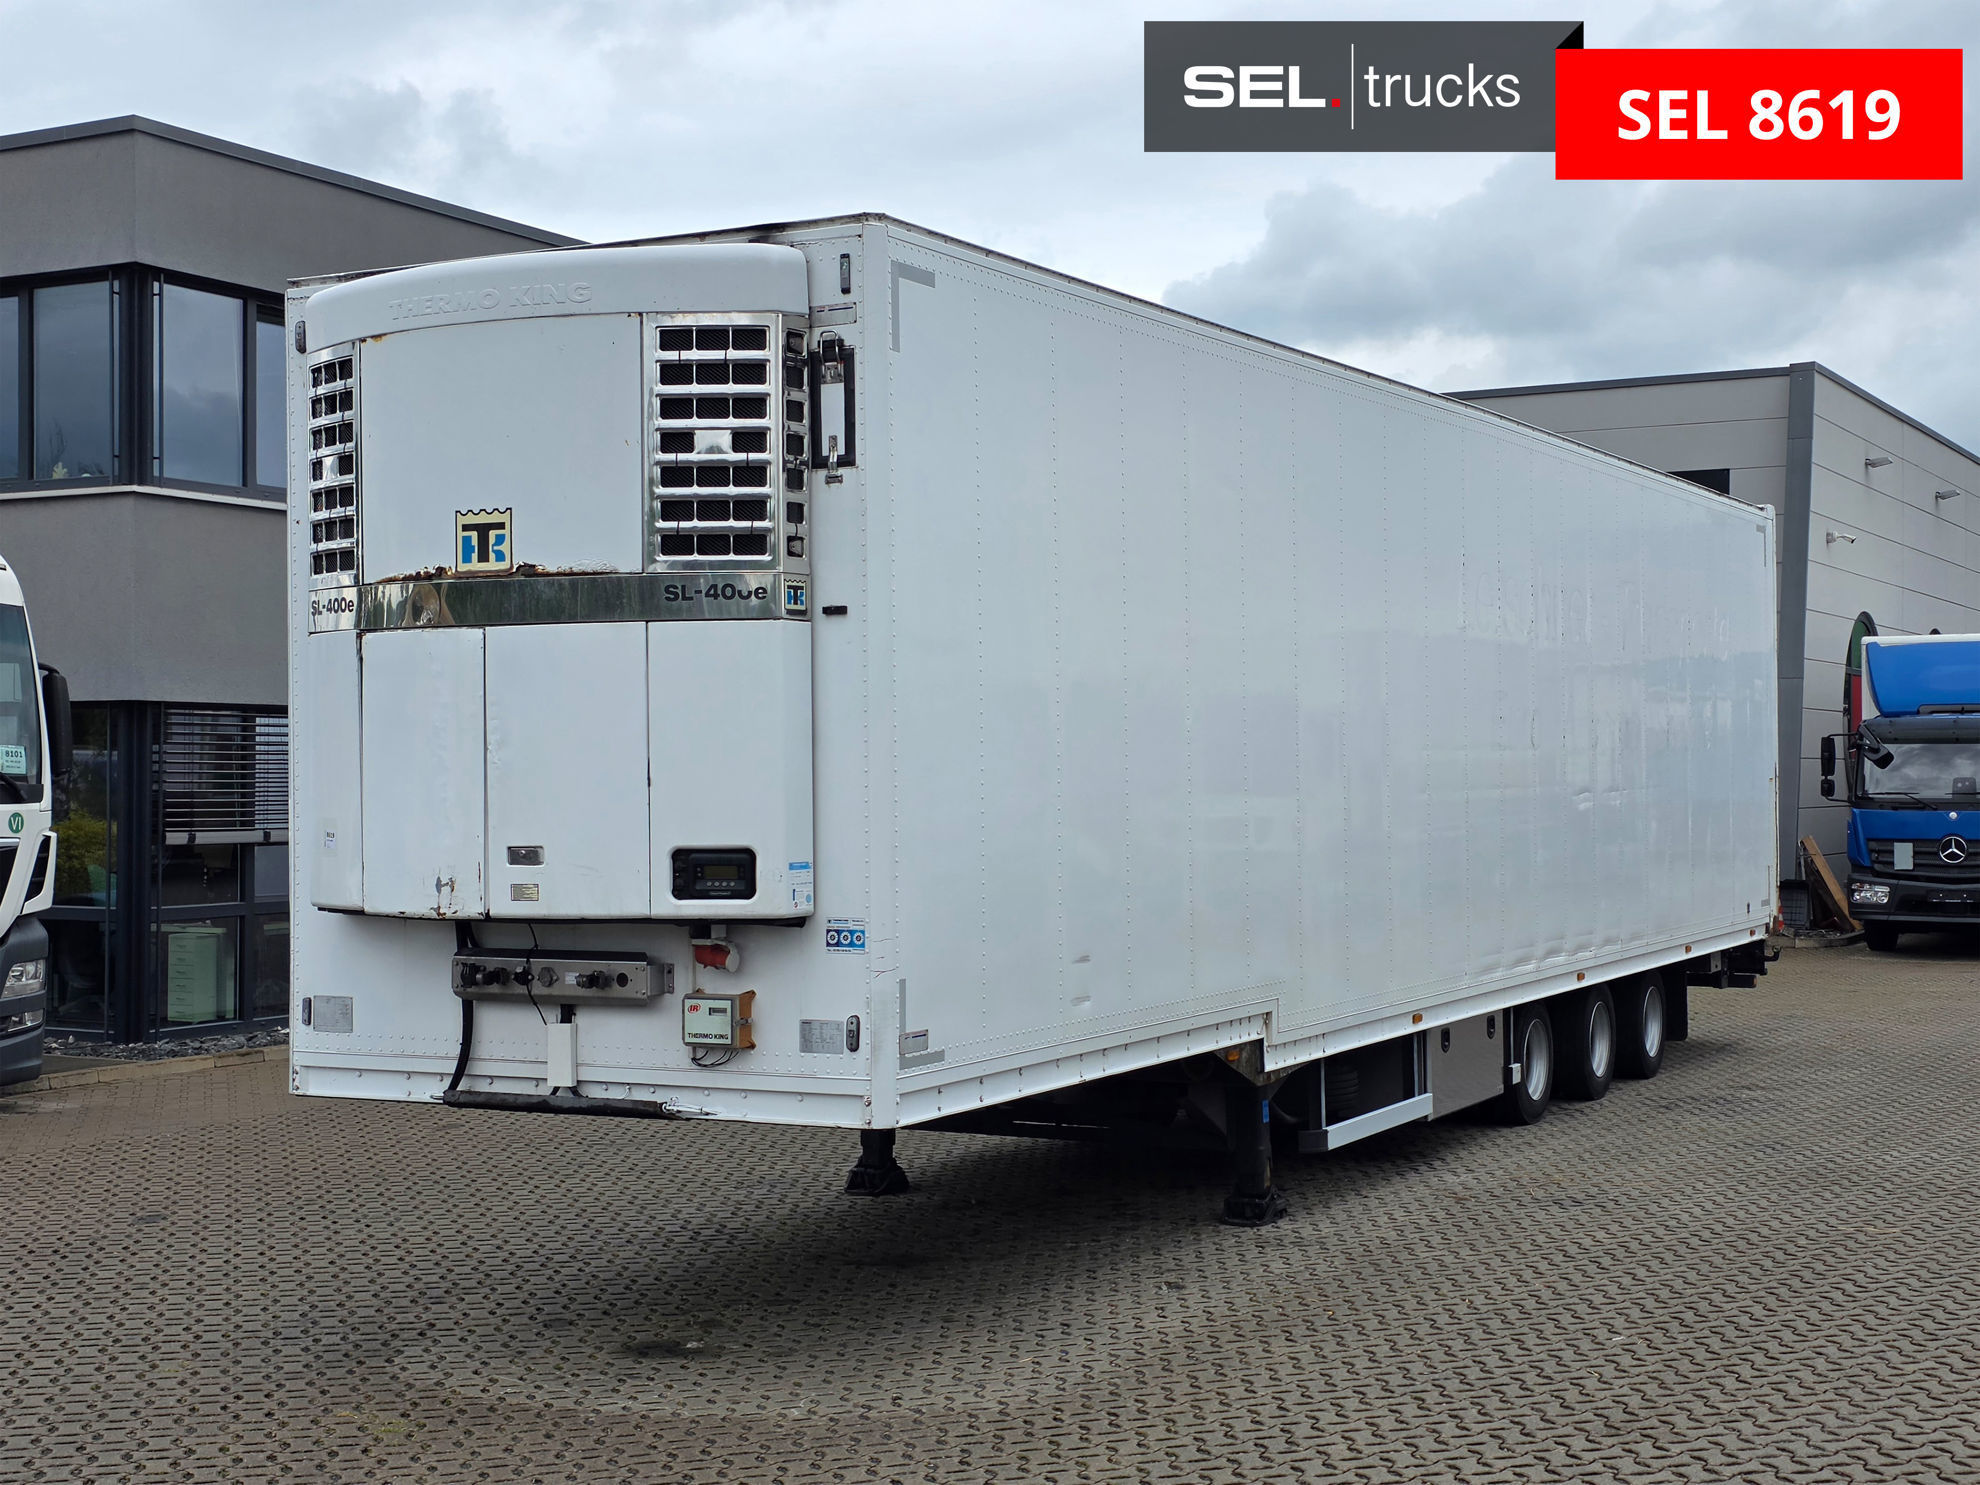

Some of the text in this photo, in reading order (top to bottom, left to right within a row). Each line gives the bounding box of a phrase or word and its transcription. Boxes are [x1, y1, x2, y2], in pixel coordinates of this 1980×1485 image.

[388, 282, 593, 321] THERMO KING
[311, 596, 355, 617] SL-400e
[4, 750, 23, 758] 8101
[688, 1032, 713, 1040] THERMO
